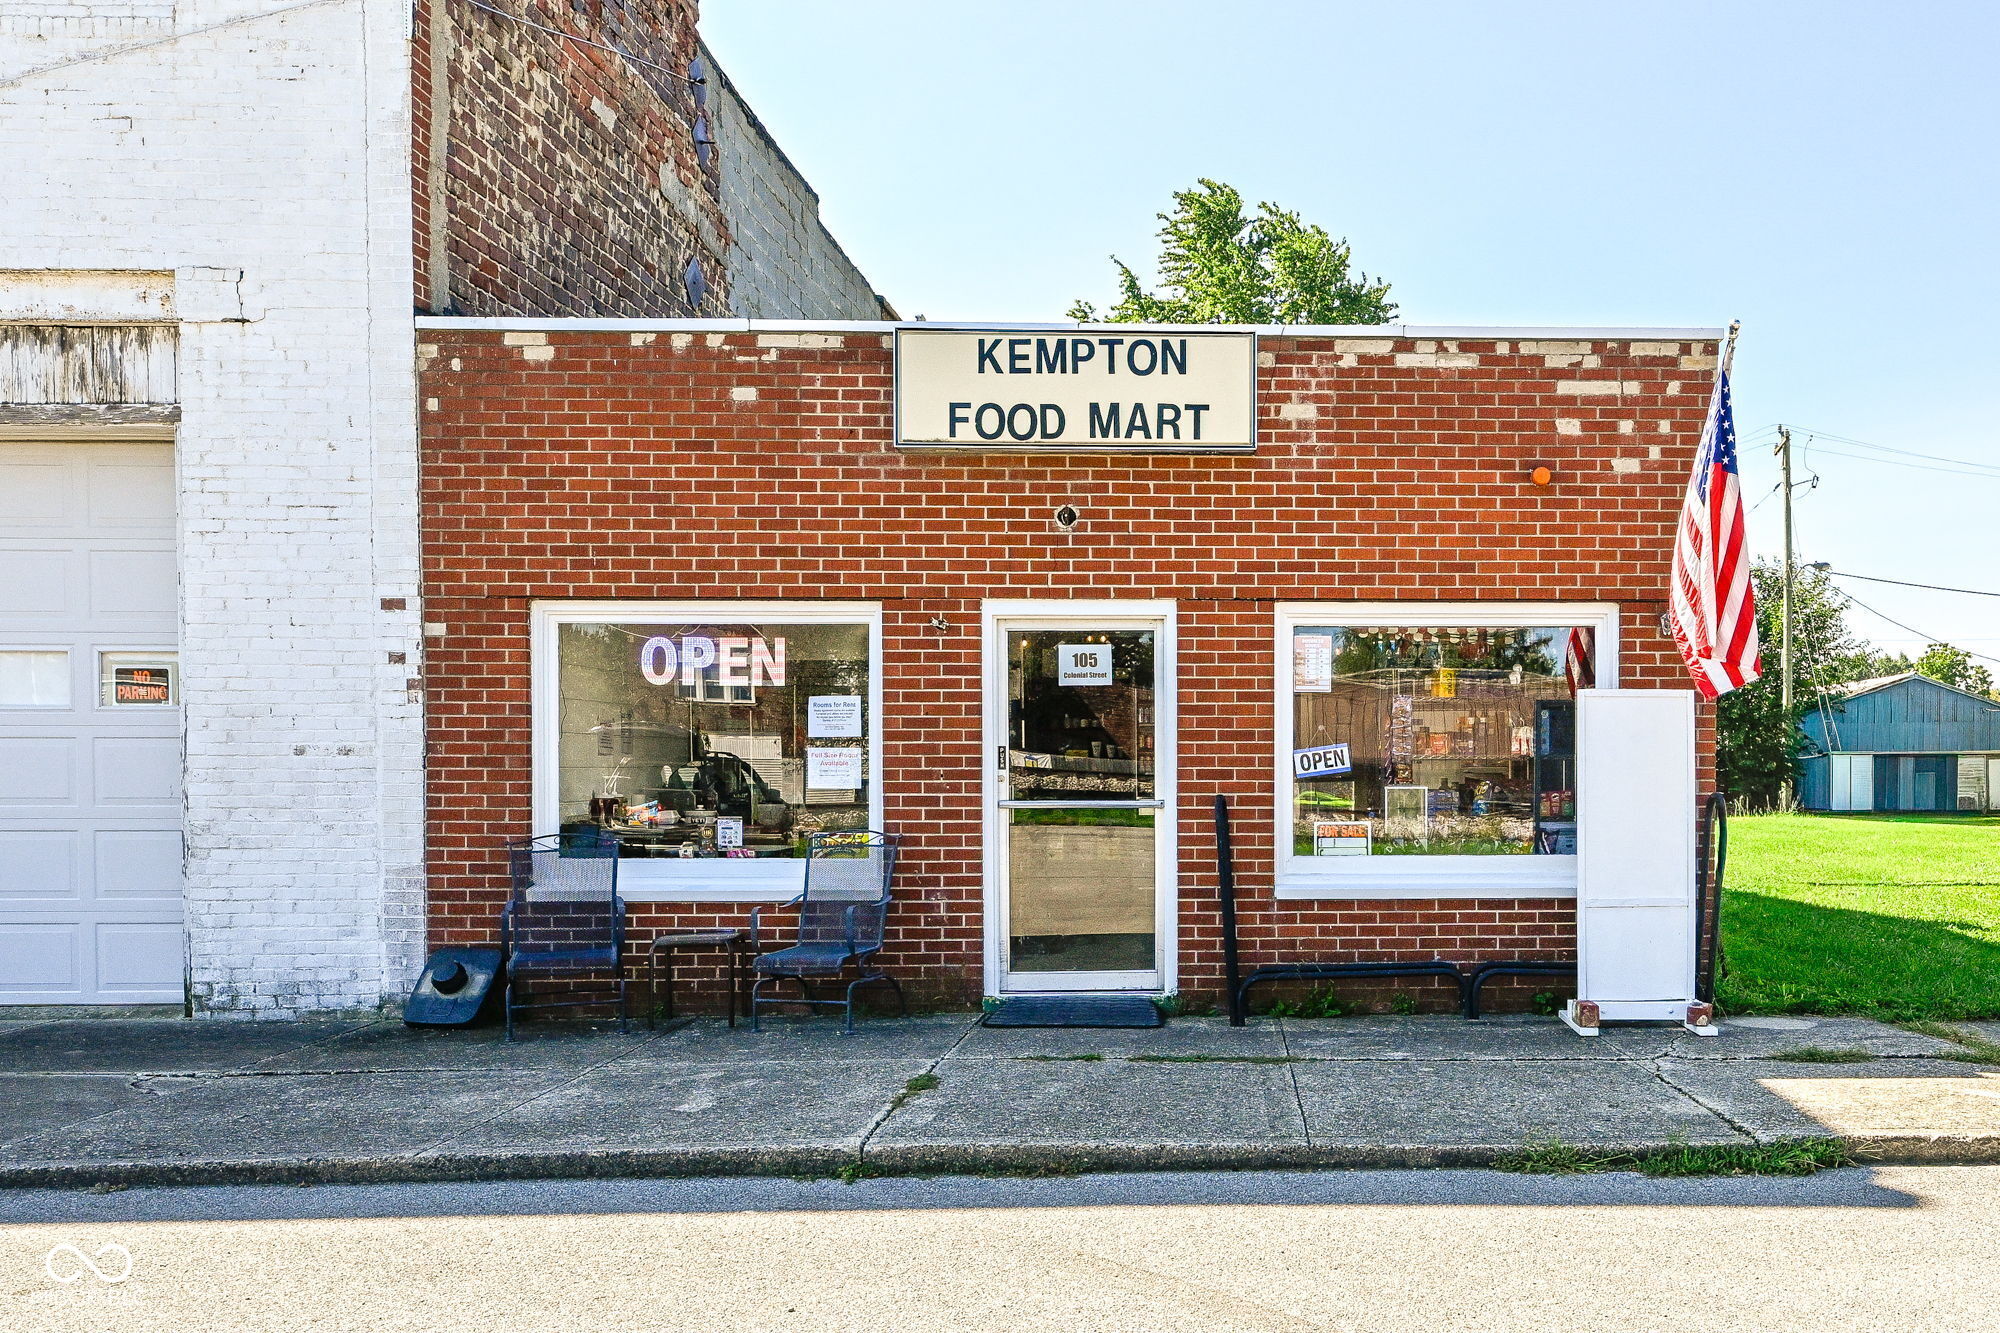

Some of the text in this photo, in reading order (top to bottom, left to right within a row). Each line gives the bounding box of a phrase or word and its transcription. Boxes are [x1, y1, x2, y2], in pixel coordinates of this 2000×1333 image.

[977, 338, 1188, 376] KEMPTON
[948, 402, 1210, 441] FOOD MART
[641, 636, 786, 686] OPEN
[1072, 652, 1098, 668] 105
[133, 670, 150, 682] NO
[1063, 671, 1107, 679] Colonial Street
[1299, 749, 1346, 772] OPEN
[1317, 825, 1367, 837] FOR SALE
